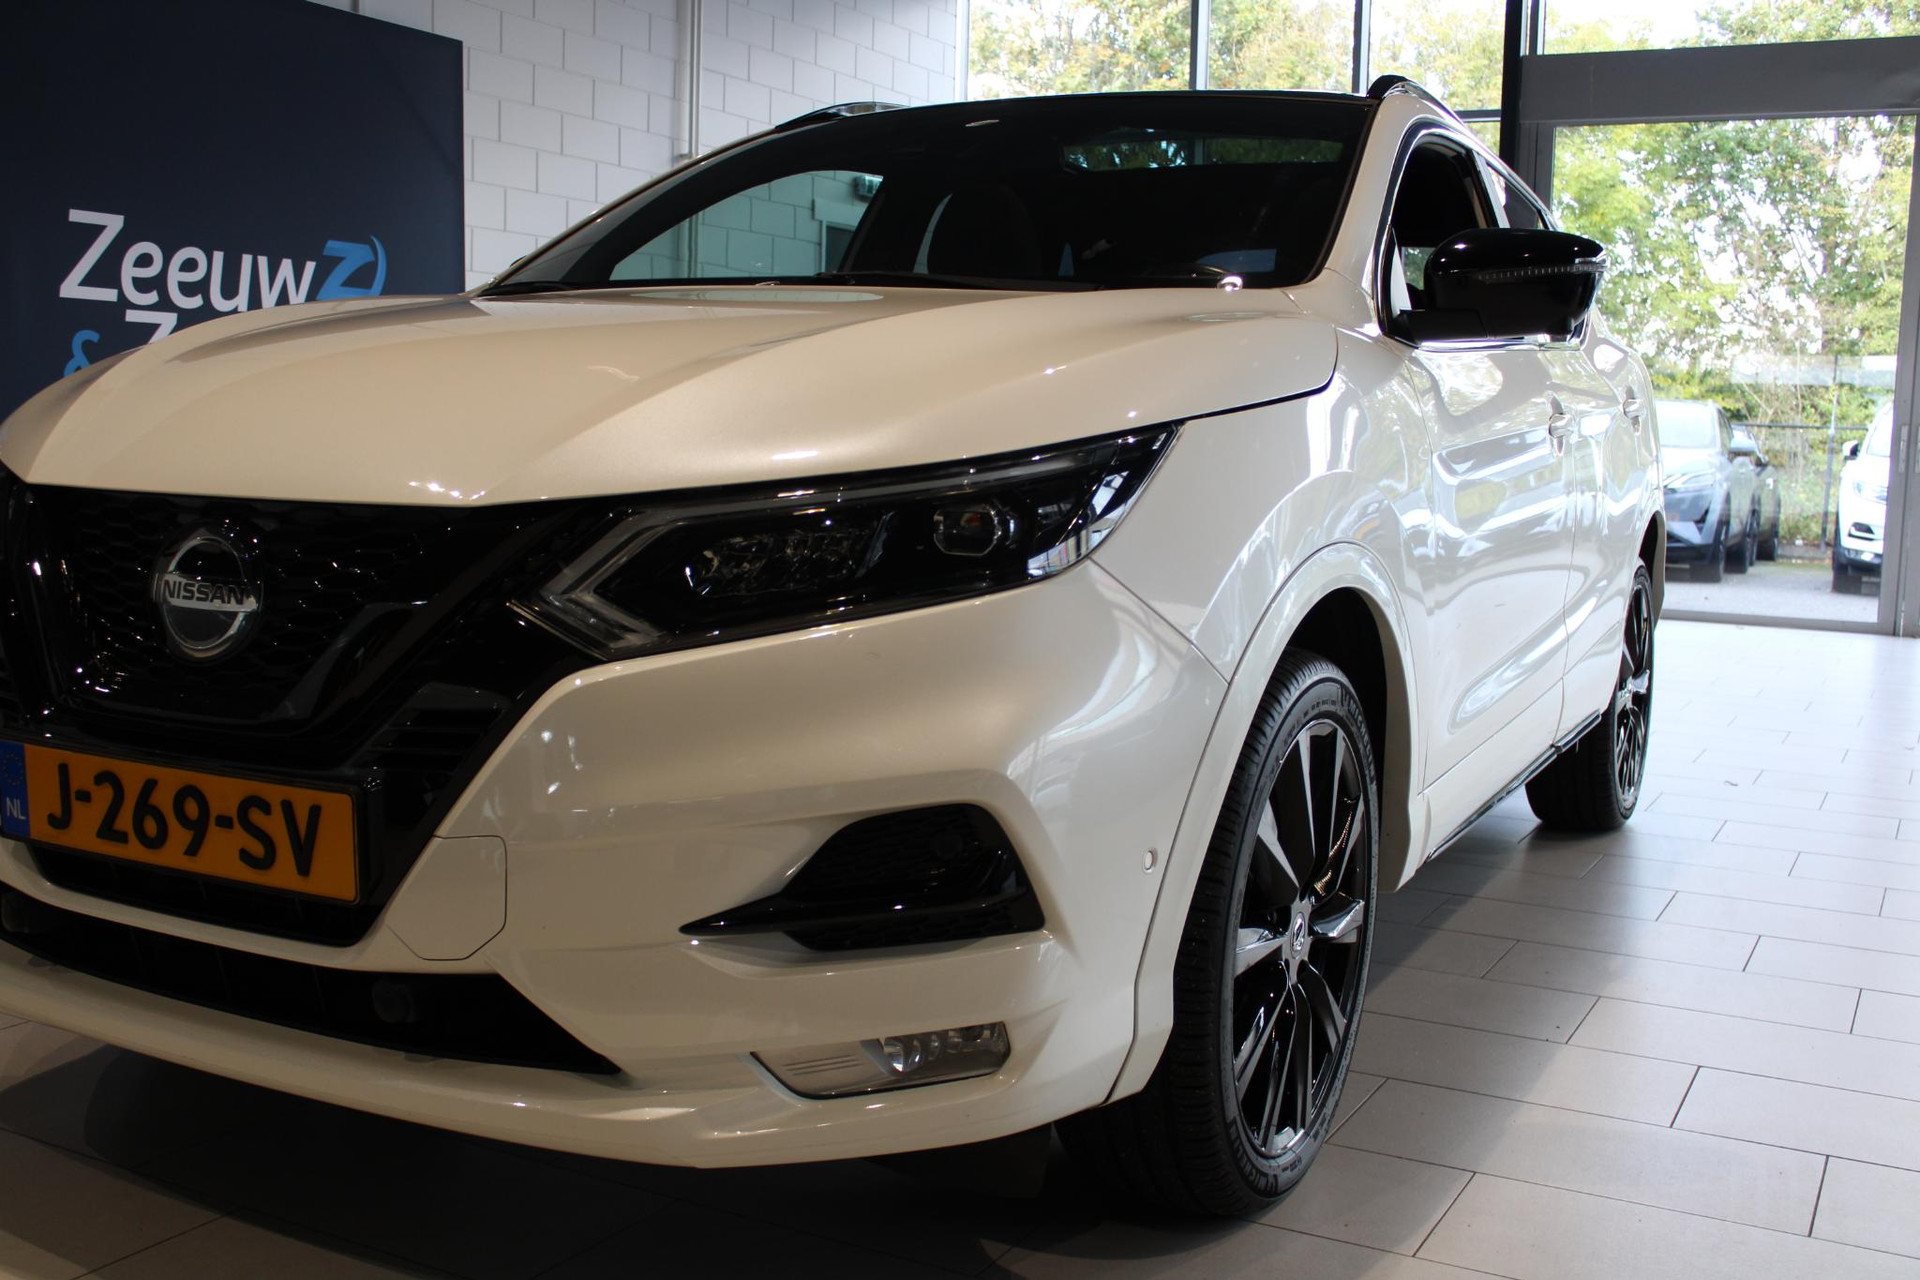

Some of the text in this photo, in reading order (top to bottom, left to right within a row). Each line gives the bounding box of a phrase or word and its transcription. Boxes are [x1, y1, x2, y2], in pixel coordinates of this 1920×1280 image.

[59, 208, 316, 312] Zeeuw
[162, 578, 245, 606] NISSAN
[6, 762, 322, 877] NL J-269-SV
